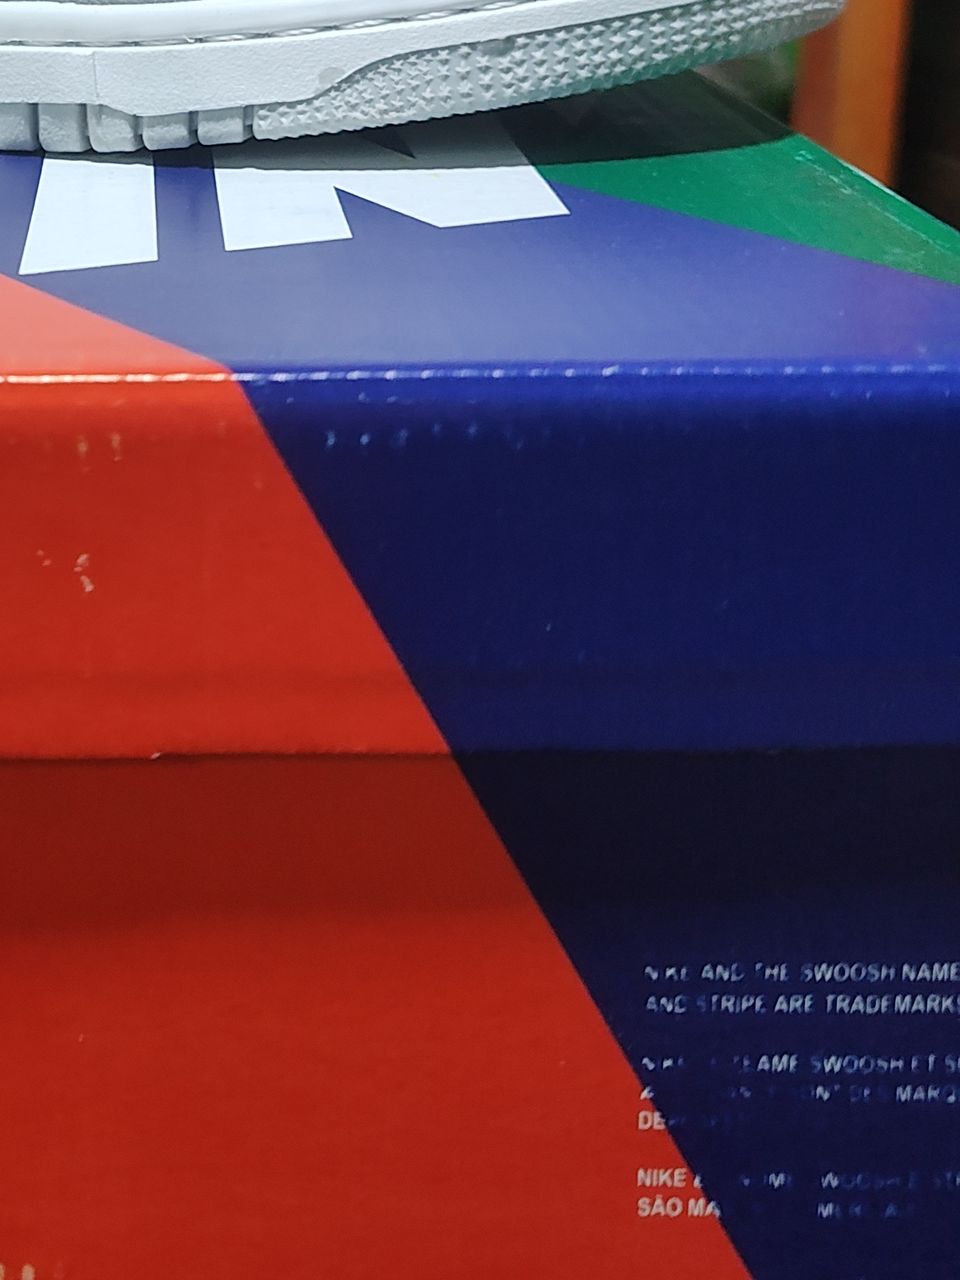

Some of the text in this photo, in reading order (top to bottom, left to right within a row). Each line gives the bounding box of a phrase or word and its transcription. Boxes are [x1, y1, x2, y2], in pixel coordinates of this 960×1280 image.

[800, 961, 896, 982] SWOOSH
[774, 993, 815, 1014] ARE
[637, 1167, 687, 1188] NIKE
